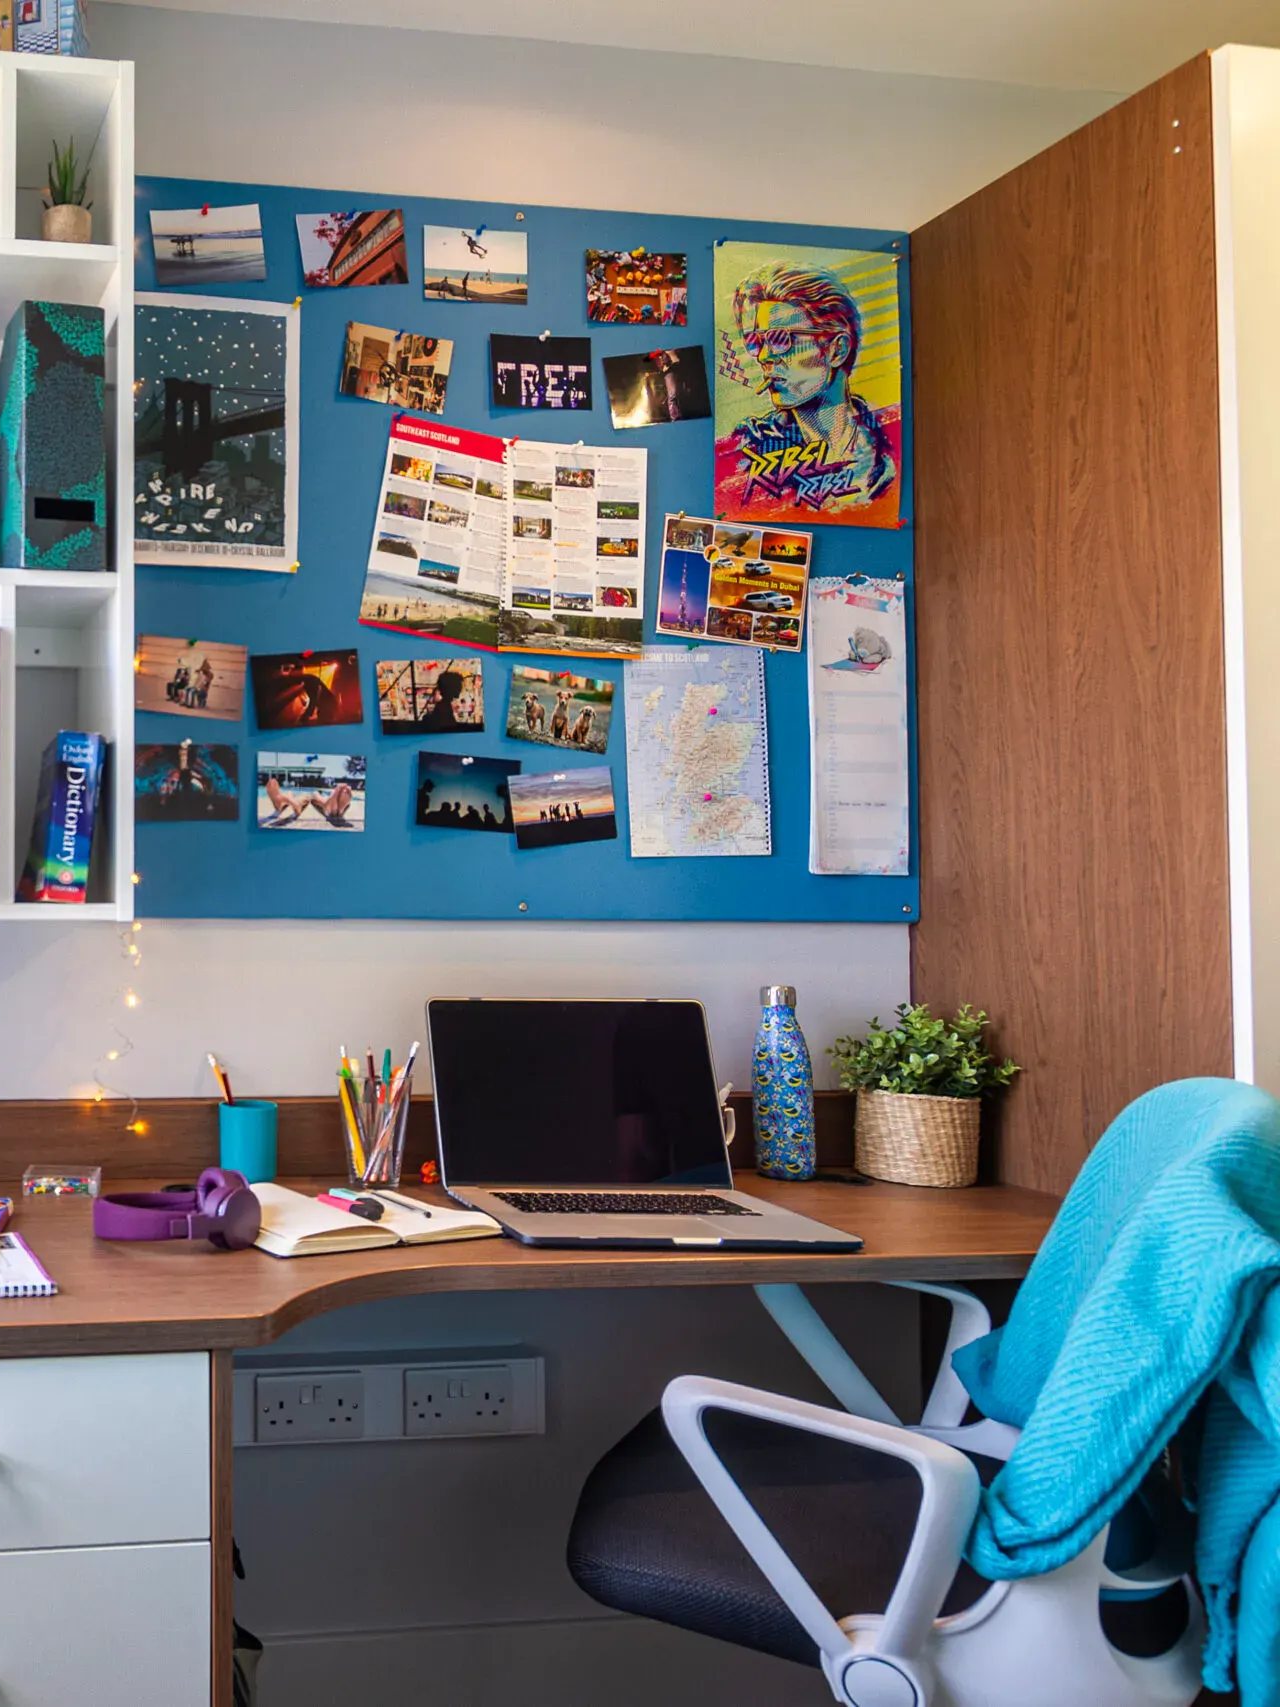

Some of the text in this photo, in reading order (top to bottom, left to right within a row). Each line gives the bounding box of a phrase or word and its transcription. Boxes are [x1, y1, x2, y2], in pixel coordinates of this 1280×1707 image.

[429, 431, 460, 446] SCOTLAND
[741, 440, 858, 507] REBEL
[793, 469, 862, 510] REBEL
[715, 573, 737, 583] Golden
[739, 577, 769, 588] Moments
[779, 582, 800, 592] Dubai
[675, 653, 709, 663] SCOTLAND
[56, 766, 87, 866] Dictionary
